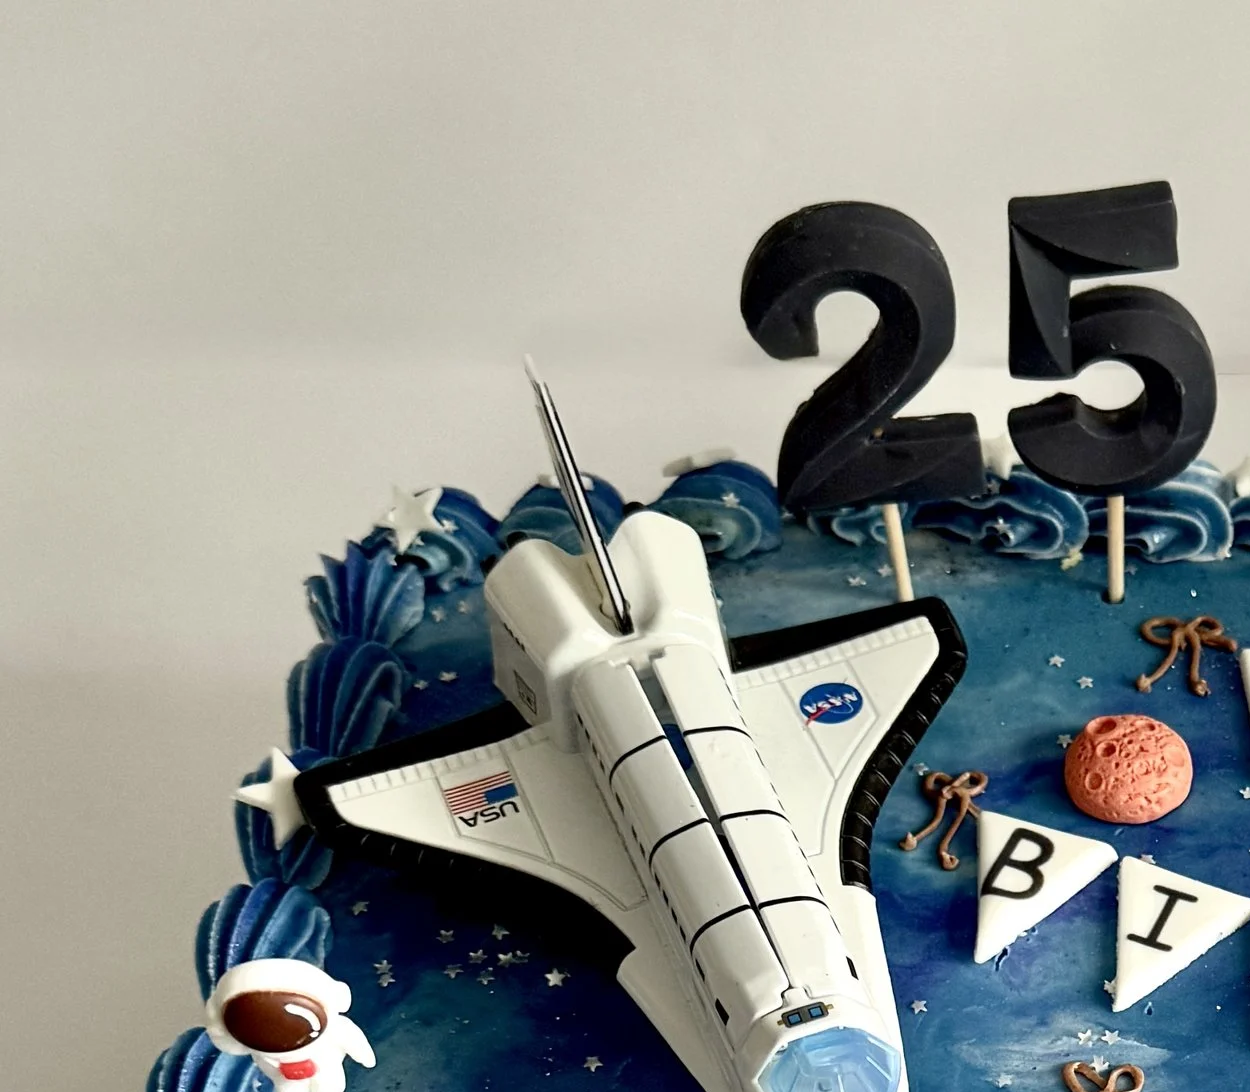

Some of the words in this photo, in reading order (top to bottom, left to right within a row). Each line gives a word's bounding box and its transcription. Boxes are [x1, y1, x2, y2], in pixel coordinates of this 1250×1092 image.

[740, 181, 1218, 511] 25
[803, 691, 859, 714] NASA
[458, 801, 520, 828] USA
